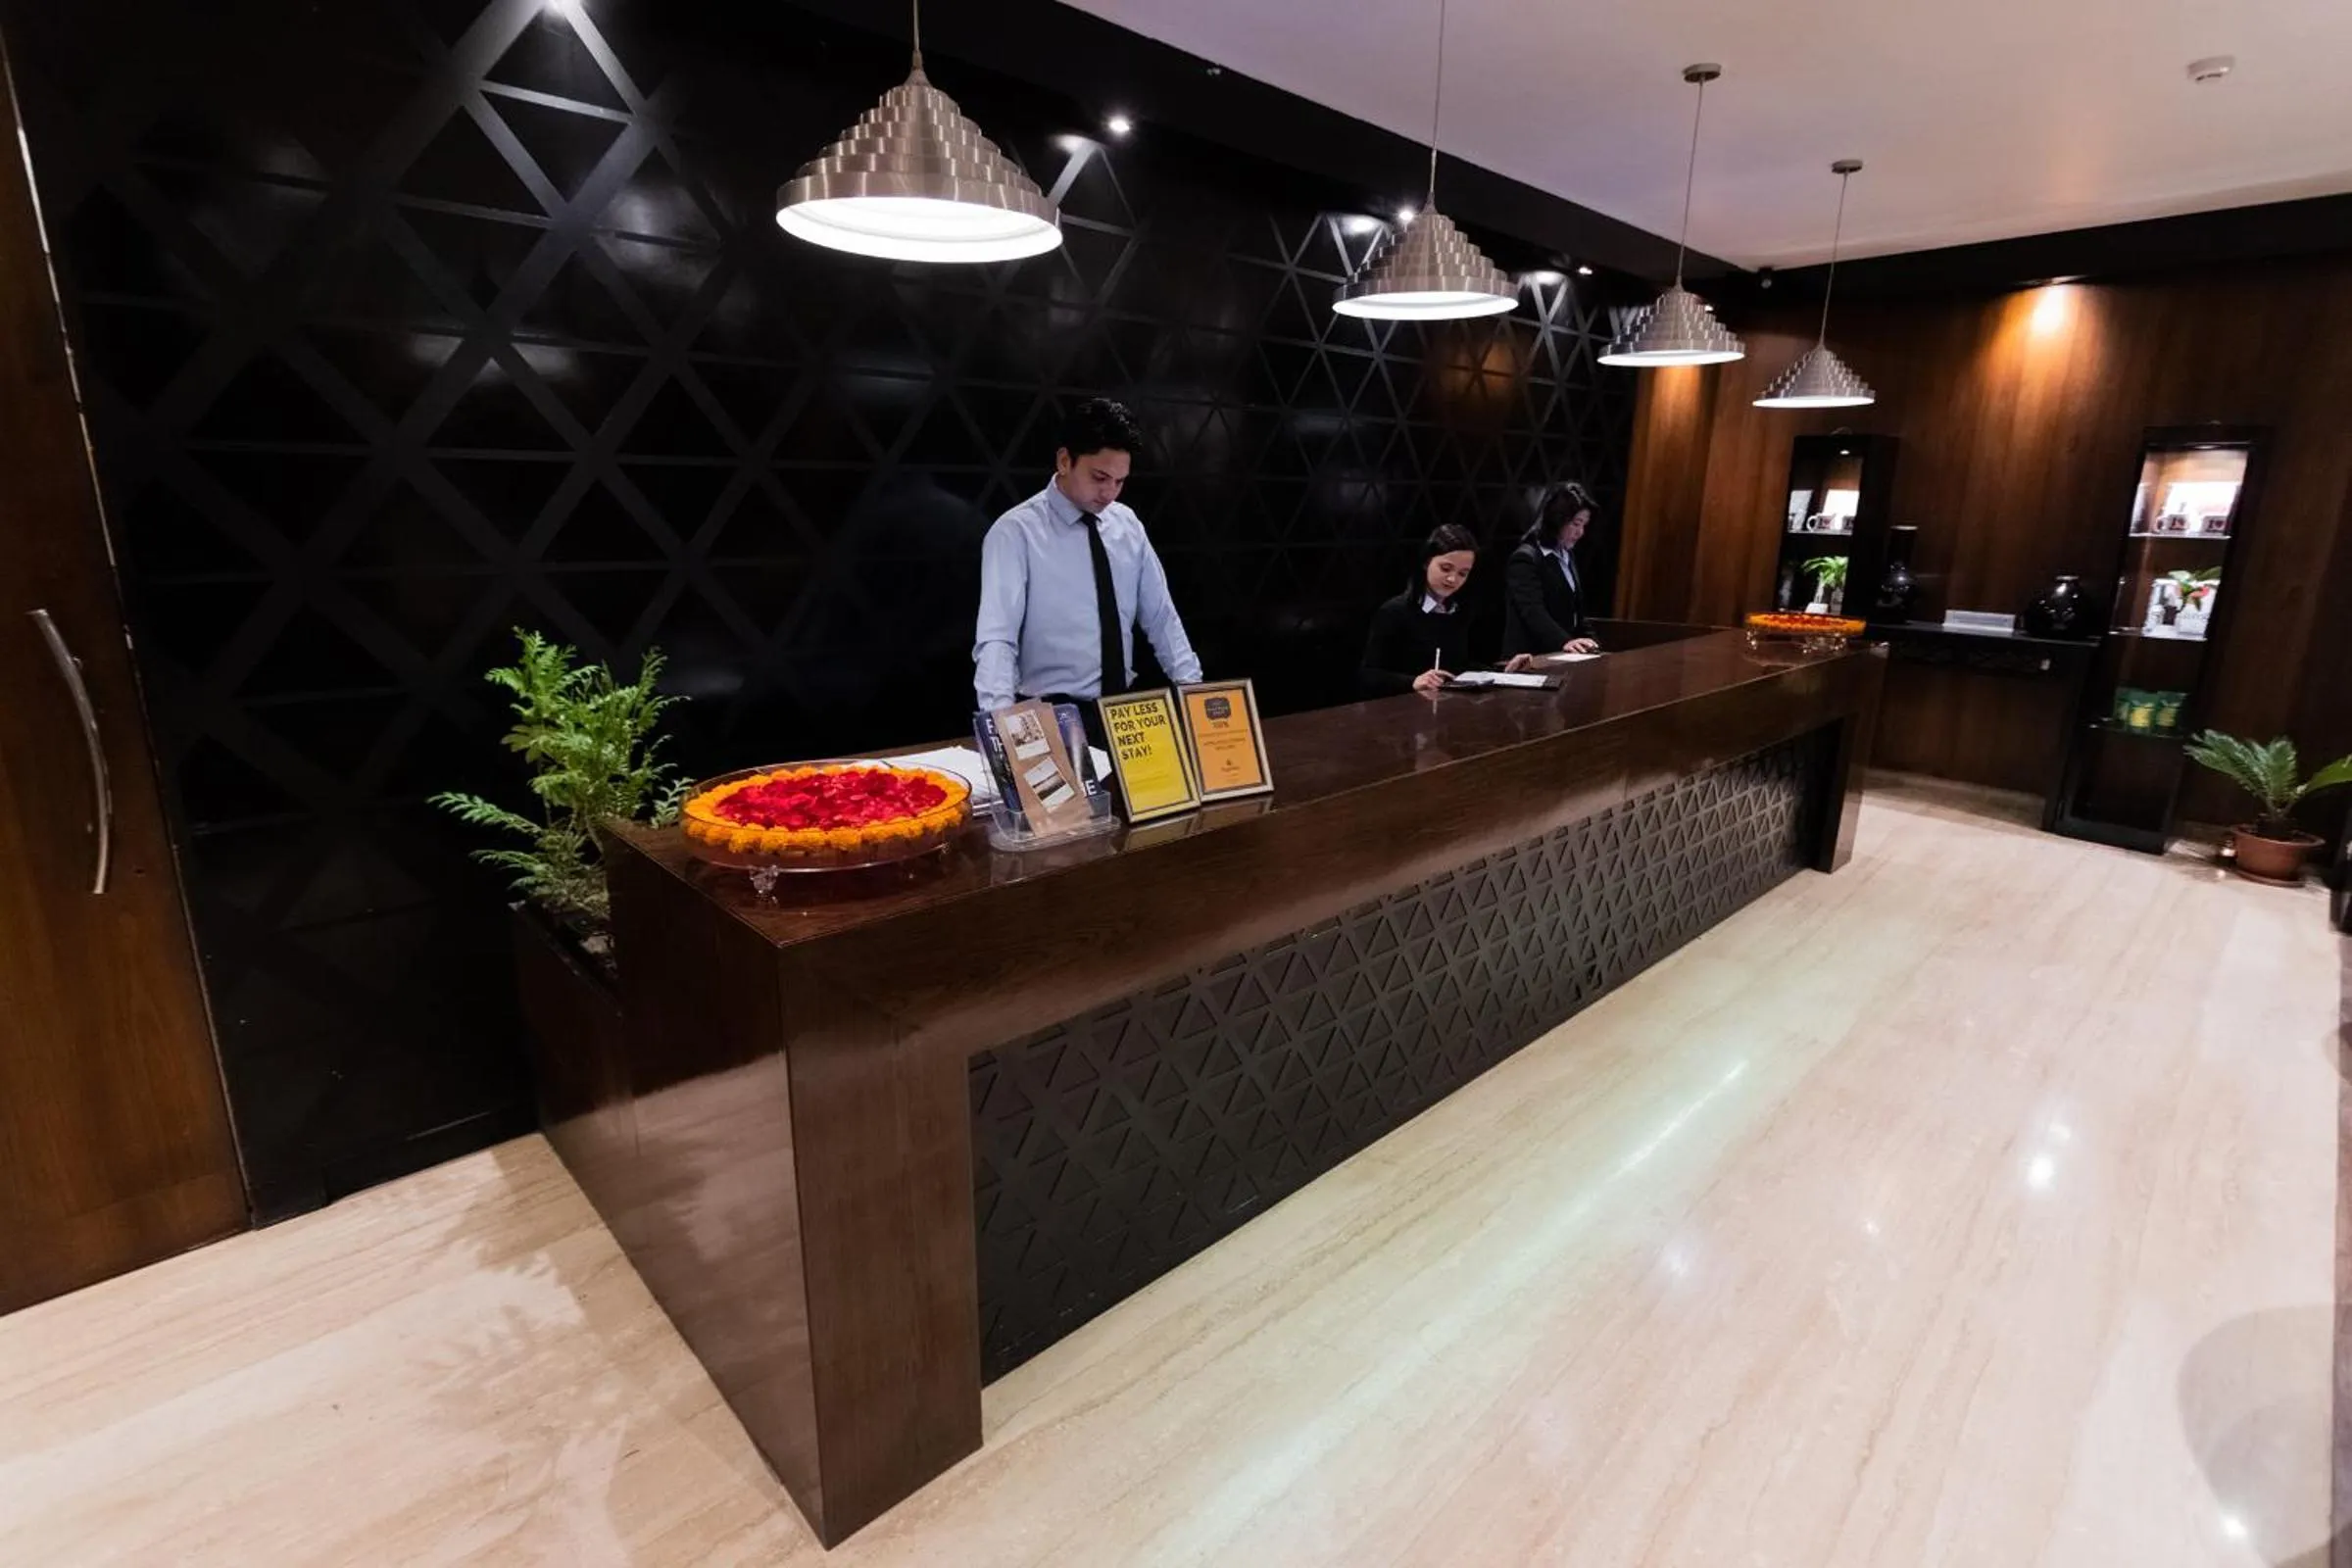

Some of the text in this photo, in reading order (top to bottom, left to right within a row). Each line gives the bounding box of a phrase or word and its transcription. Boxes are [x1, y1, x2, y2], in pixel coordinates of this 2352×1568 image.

[1109, 703, 1158, 719] PAY LESS
[1113, 714, 1166, 732] FOR YOUR
[1117, 732, 1145, 746] NEXT
[1121, 745, 1152, 760] STAY!
